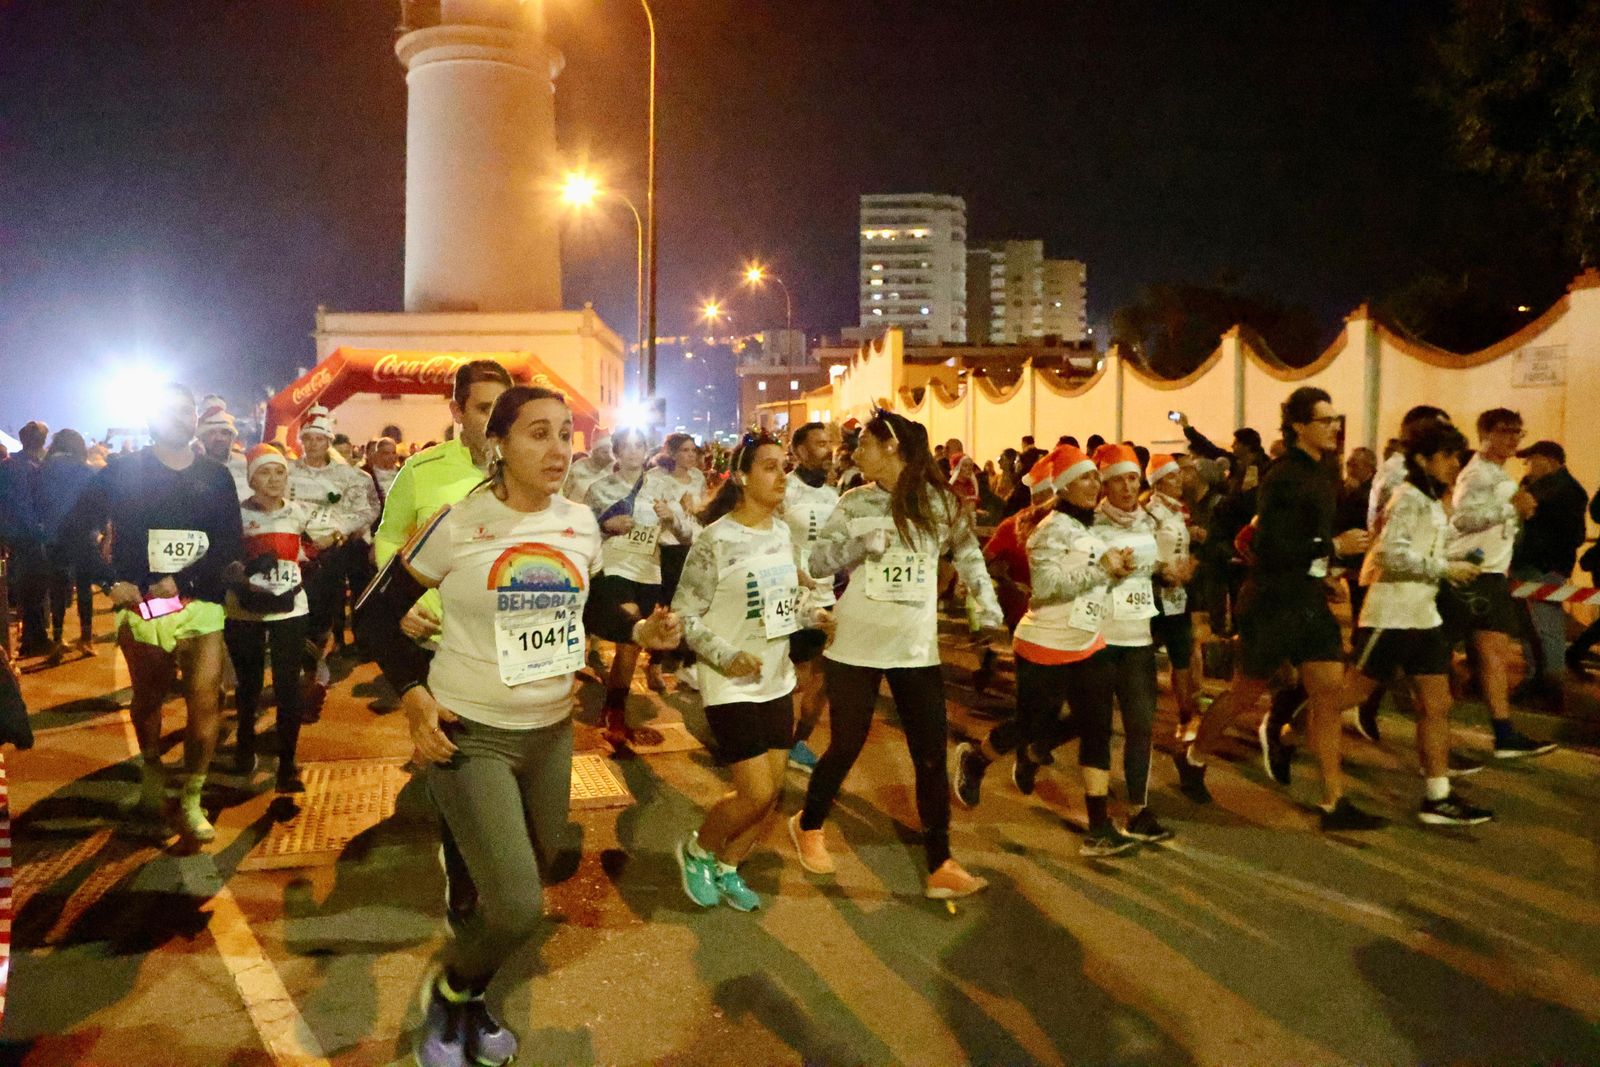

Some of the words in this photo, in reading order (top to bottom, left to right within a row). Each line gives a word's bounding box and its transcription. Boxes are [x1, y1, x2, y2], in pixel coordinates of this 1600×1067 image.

[373, 354, 472, 384] Coca-Col
[292, 368, 331, 404] Coca-Cola
[163, 542, 194, 556] 487
[883, 566, 911, 582] 121
[497, 593, 577, 611] BEHOBIA
[518, 626, 564, 651] 1041
